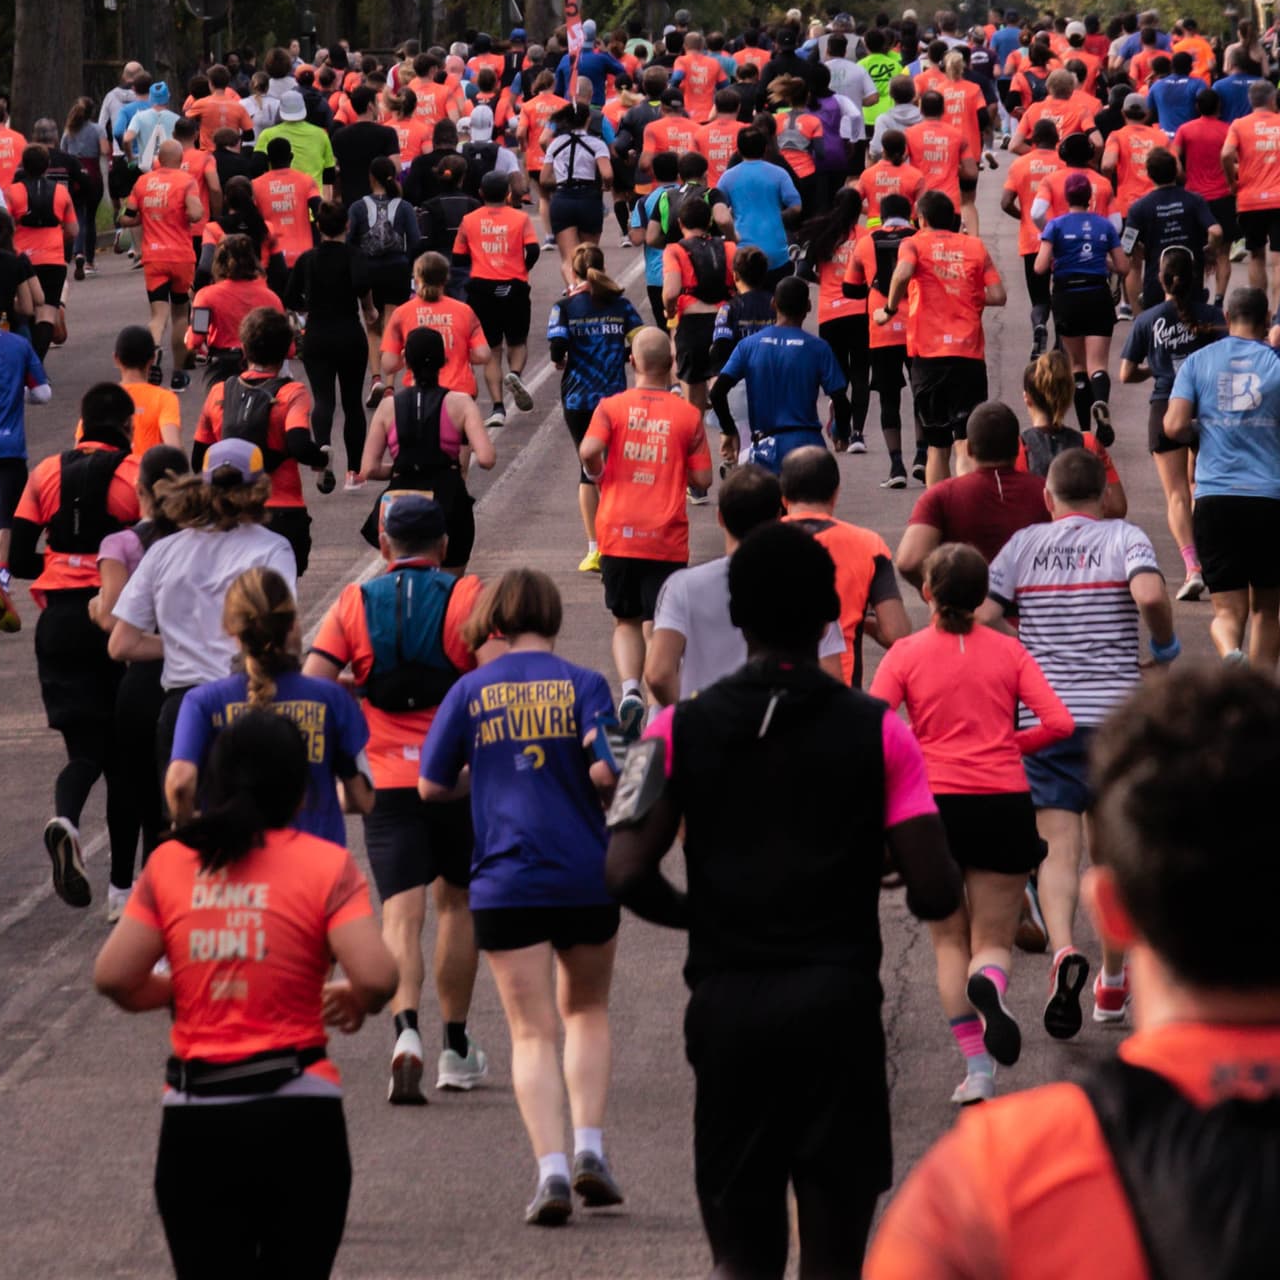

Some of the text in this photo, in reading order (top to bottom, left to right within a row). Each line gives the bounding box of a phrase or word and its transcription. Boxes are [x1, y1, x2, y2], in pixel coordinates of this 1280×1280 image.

[569, 325, 602, 338] TEAM
[1153, 317, 1176, 349] Run
[629, 406, 648, 418] LET'S
[628, 416, 671, 436] DANCE
[646, 435, 667, 446] LET'S
[624, 440, 658, 464] RUN
[476, 716, 505, 747] AIT
[191, 882, 270, 910] DANCE
[226, 911, 263, 929] LET'S
[189, 928, 248, 964] RUN
